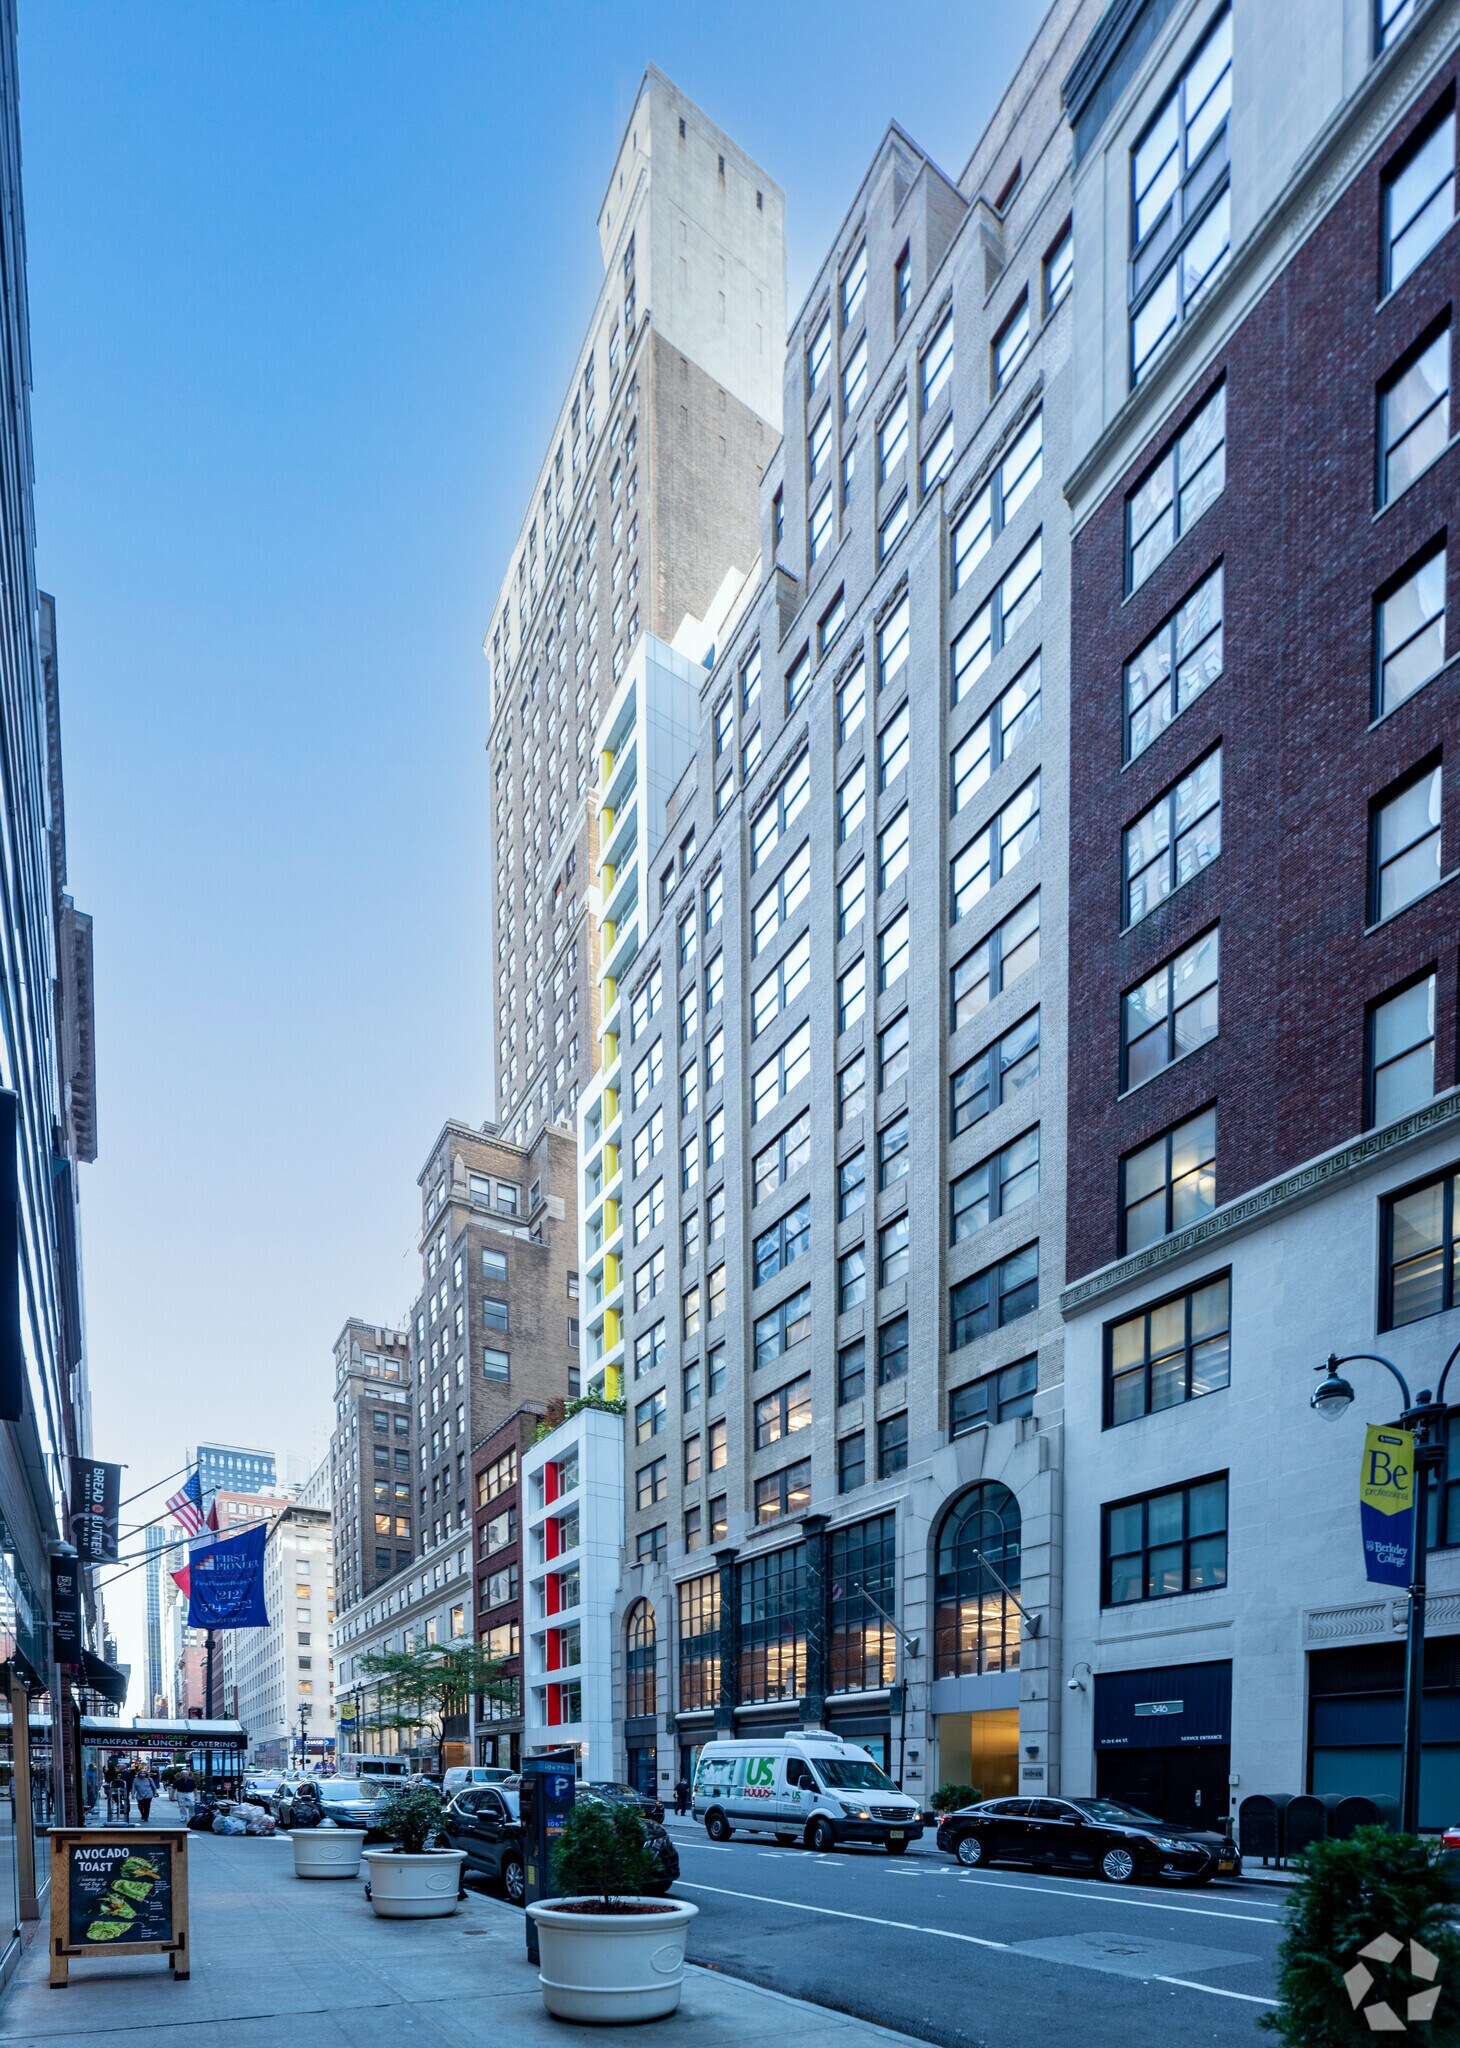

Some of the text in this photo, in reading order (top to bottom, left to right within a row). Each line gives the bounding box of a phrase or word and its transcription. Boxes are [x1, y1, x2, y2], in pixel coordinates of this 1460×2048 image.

[1367, 1449, 1408, 1490] Be
[92, 1467, 104, 1503] BREAD
[84, 1503, 90, 1512] TO
[91, 1515, 103, 1556] BUTTER
[1374, 1541, 1408, 1558] Berkeley
[215, 1553, 248, 1563] FIRST
[1376, 1552, 1405, 1568] College
[215, 1588, 243, 1601] (212)
[1151, 1704, 1168, 1714] 346
[84, 1737, 238, 1748] BREAKFAST LUNCH CATERING
[743, 1786, 770, 1798] FOODS
[74, 1847, 130, 1860] AVOCADO
[78, 1861, 113, 1872] TOAST
